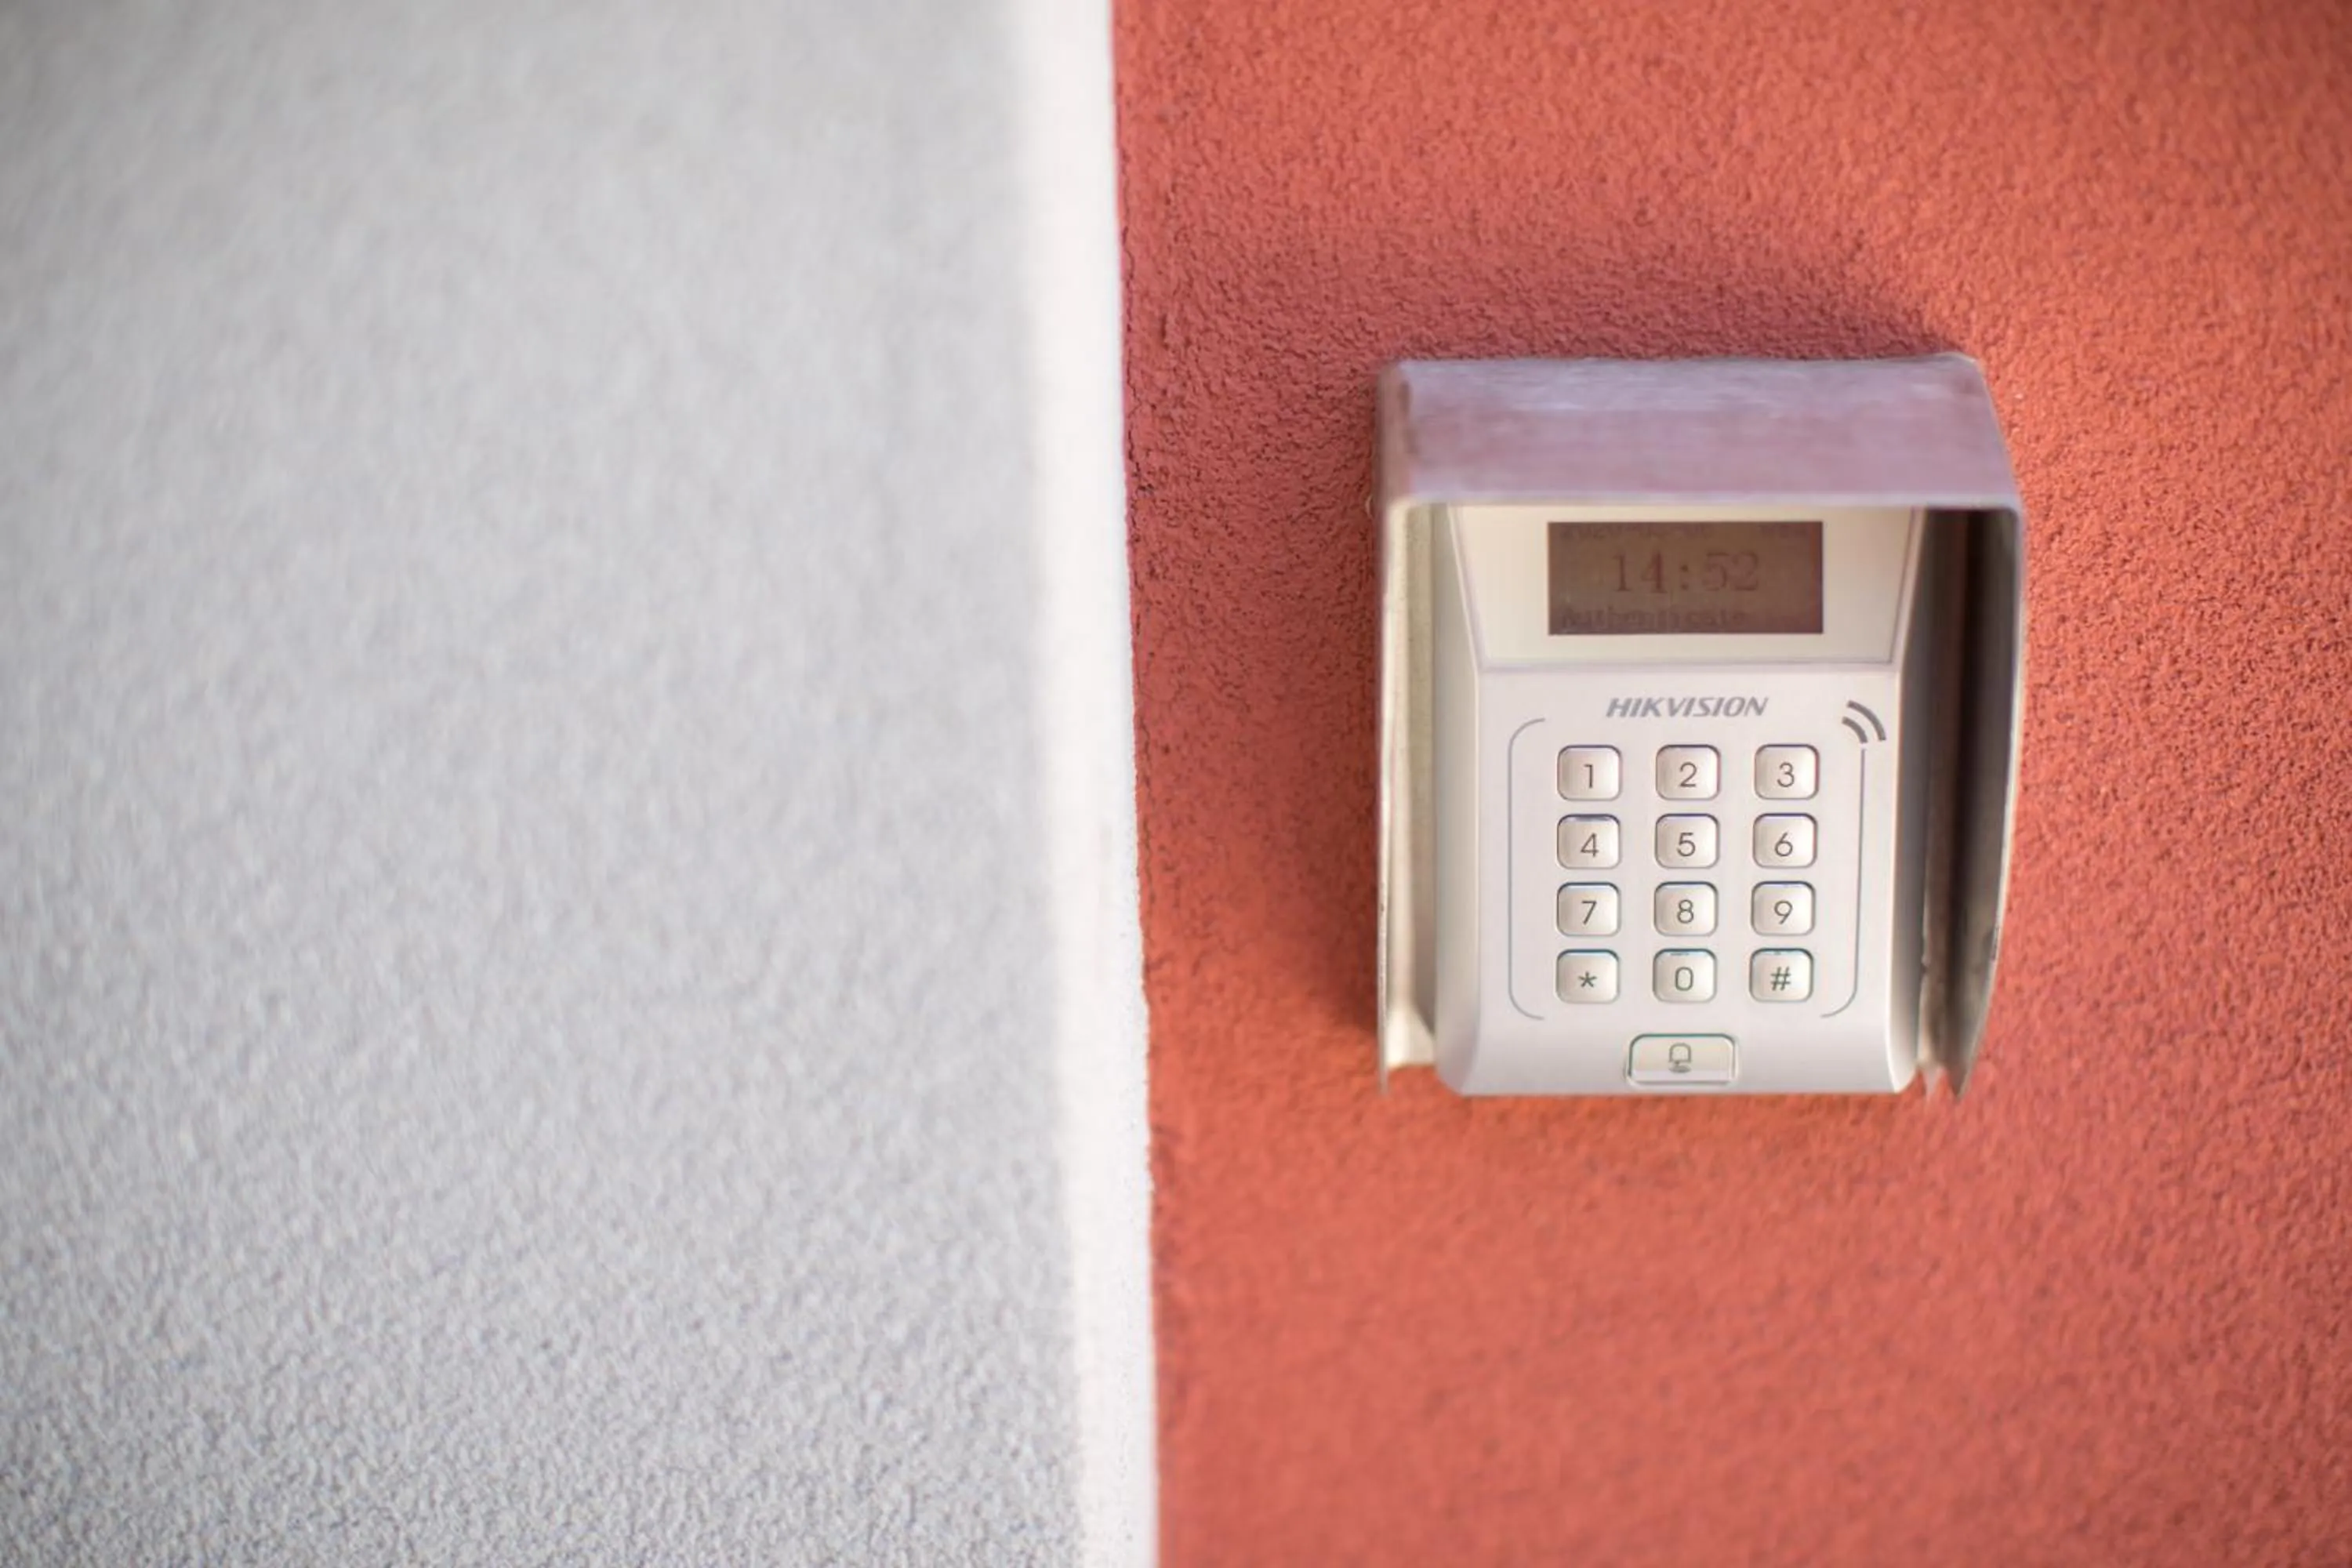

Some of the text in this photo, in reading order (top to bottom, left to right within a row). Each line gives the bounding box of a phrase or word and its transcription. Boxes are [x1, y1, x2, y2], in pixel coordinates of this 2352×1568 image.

[1612, 550, 1759, 594] 14:52
[1606, 696, 1769, 718] HIKVISION
[1583, 761, 1795, 789] 1 2 3
[1580, 832, 1794, 858] 4 5 6
[1581, 898, 1793, 926] 7 8 9
[1674, 966, 1694, 992] 0
[1769, 966, 1791, 992] #
